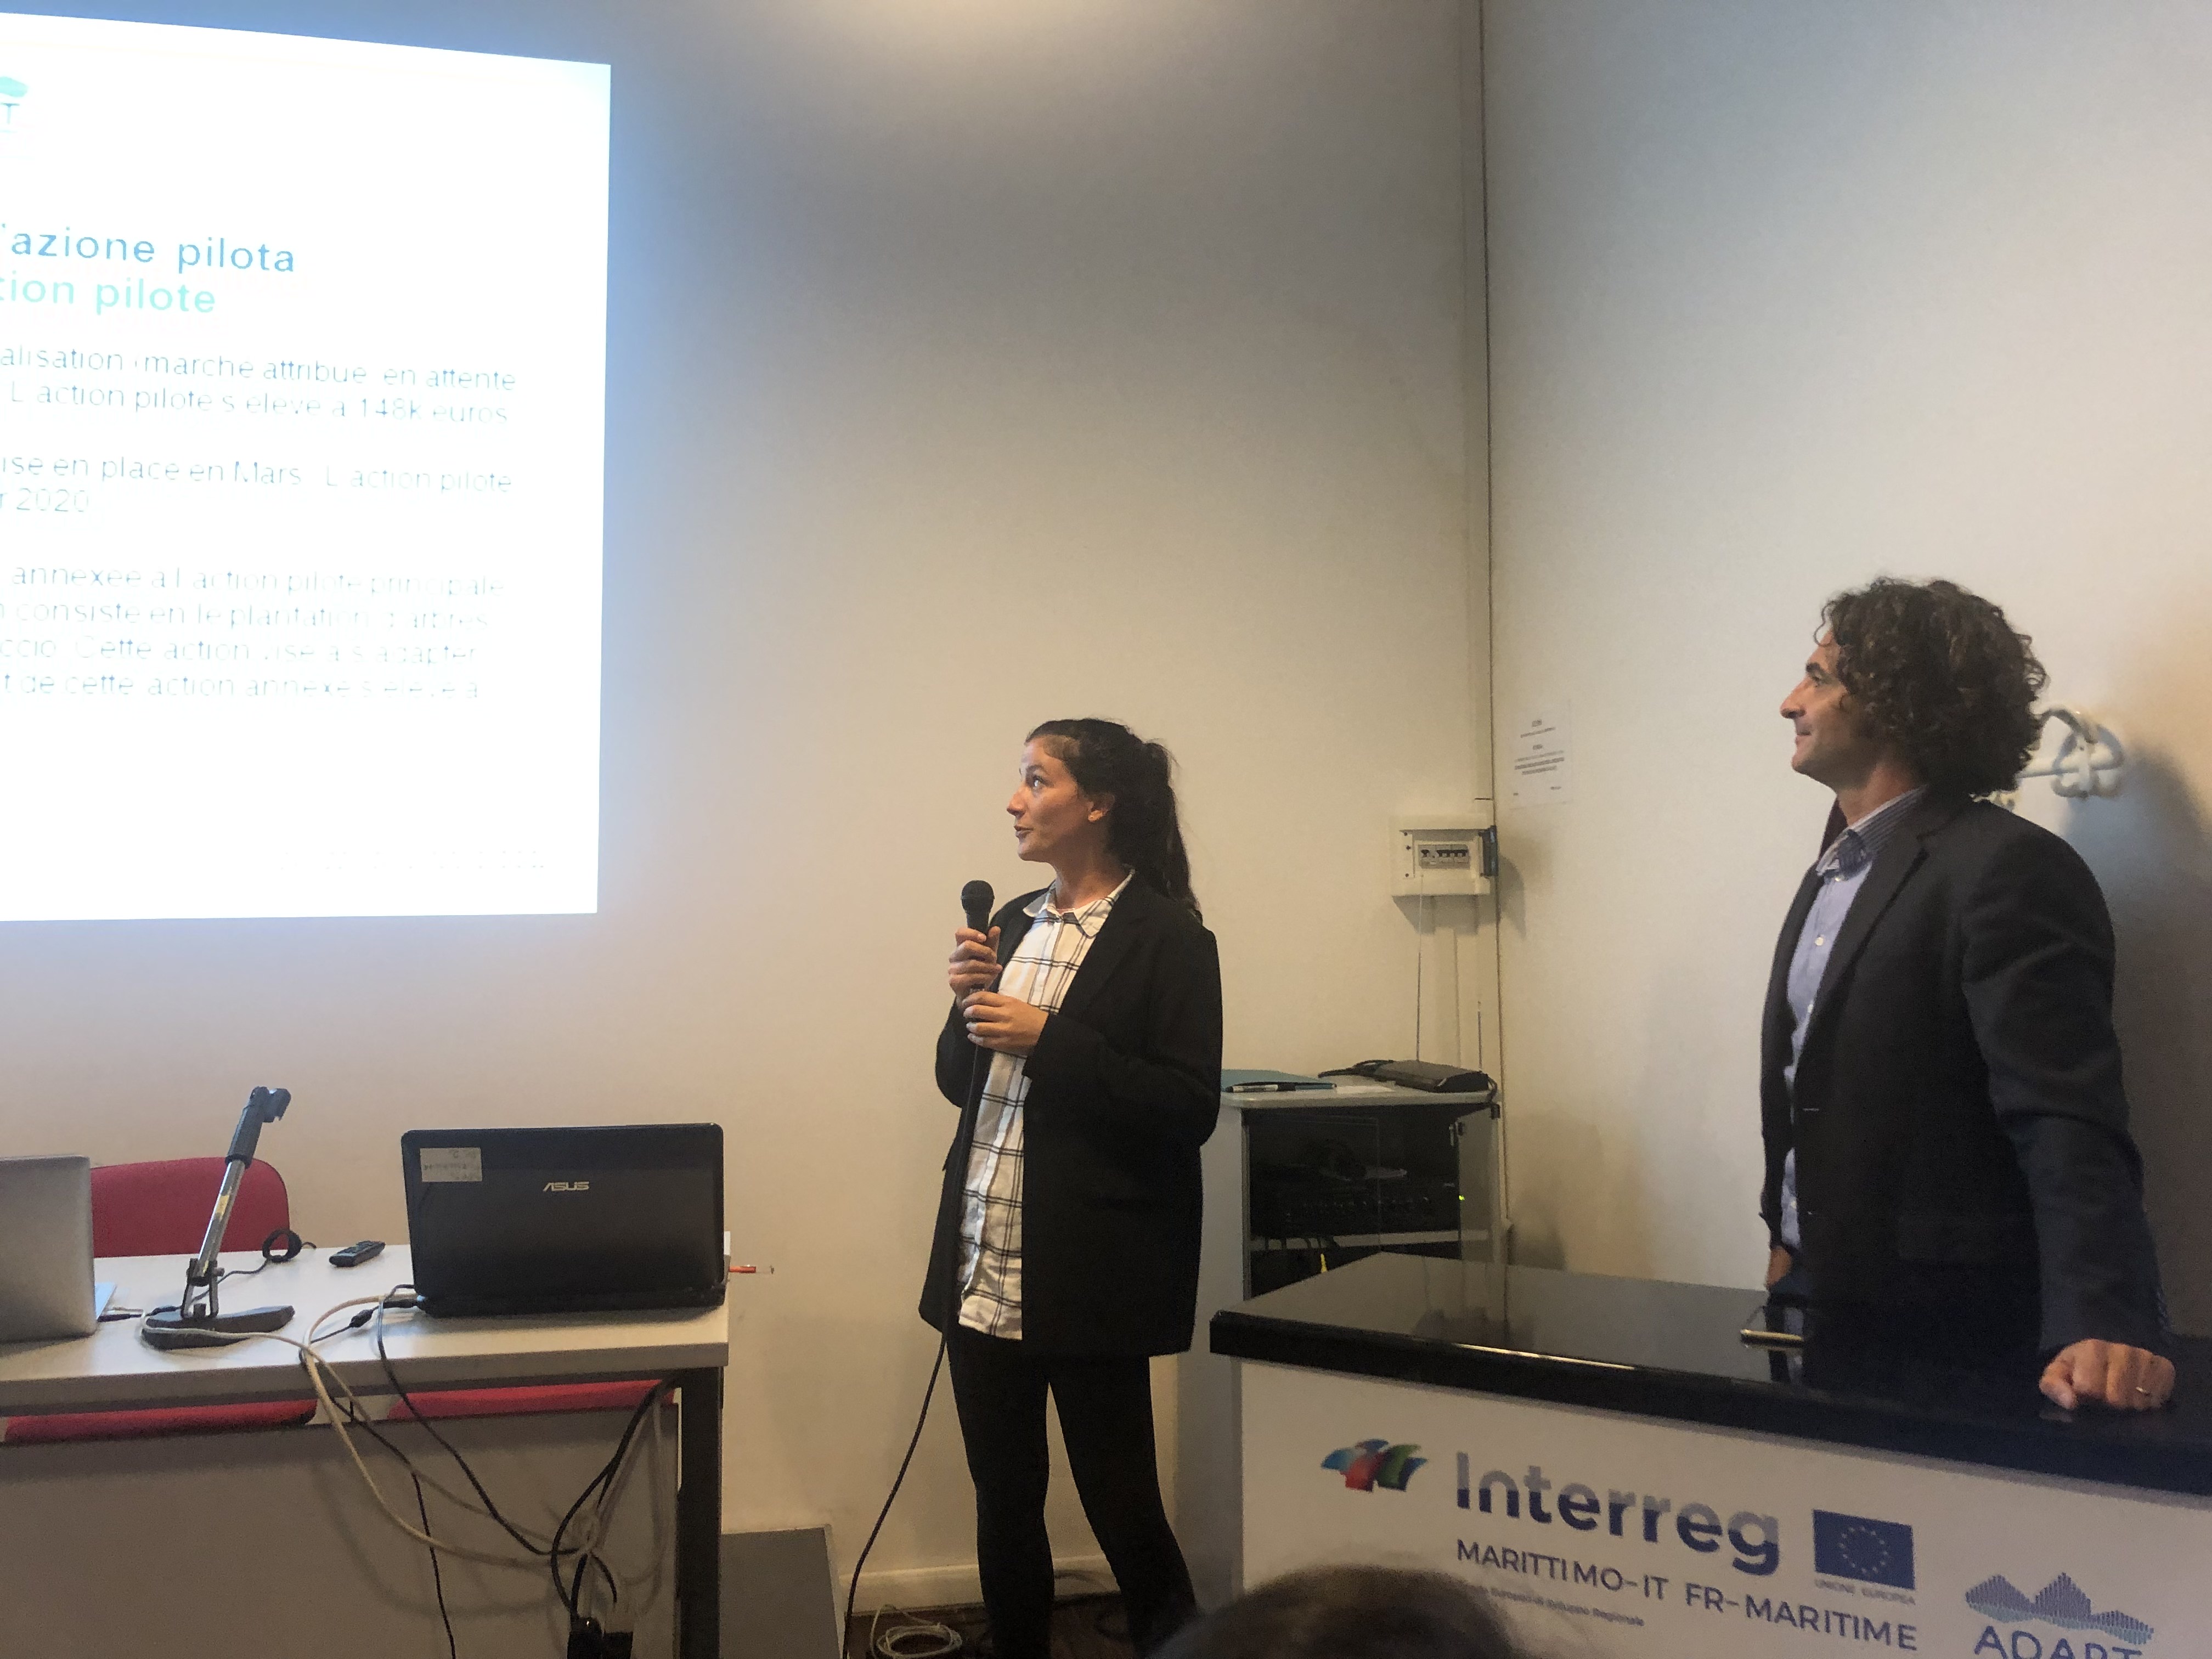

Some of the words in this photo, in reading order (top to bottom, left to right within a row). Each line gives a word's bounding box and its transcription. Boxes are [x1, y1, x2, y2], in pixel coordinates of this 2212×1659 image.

[177, 237, 295, 274] pilota
[0, 270, 75, 304] ion
[95, 277, 216, 316] pilote
[0, 345, 123, 371] alisation
[383, 369, 416, 385] en
[426, 369, 516, 391] attente
[136, 386, 212, 413] pilote
[332, 401, 346, 417] a
[360, 398, 421, 420] 148k
[432, 405, 507, 424] euros
[53, 459, 88, 477] en
[102, 456, 180, 483] place
[189, 464, 224, 482] en
[234, 461, 302, 485] Mars
[441, 471, 511, 494] pilote
[16, 487, 89, 512] 2020
[12, 567, 141, 587] annexee
[151, 572, 166, 588] a
[287, 572, 360, 596] pilote
[16, 603, 140, 623] consiste
[149, 607, 184, 623] en
[198, 603, 221, 624] le
[76, 636, 151, 659] Cette
[164, 641, 249, 661] action
[65, 674, 134, 696] cette
[148, 676, 234, 697] action
[543, 1181, 590, 1192] ASUS
[1456, 1451, 1780, 1576] Interreg
